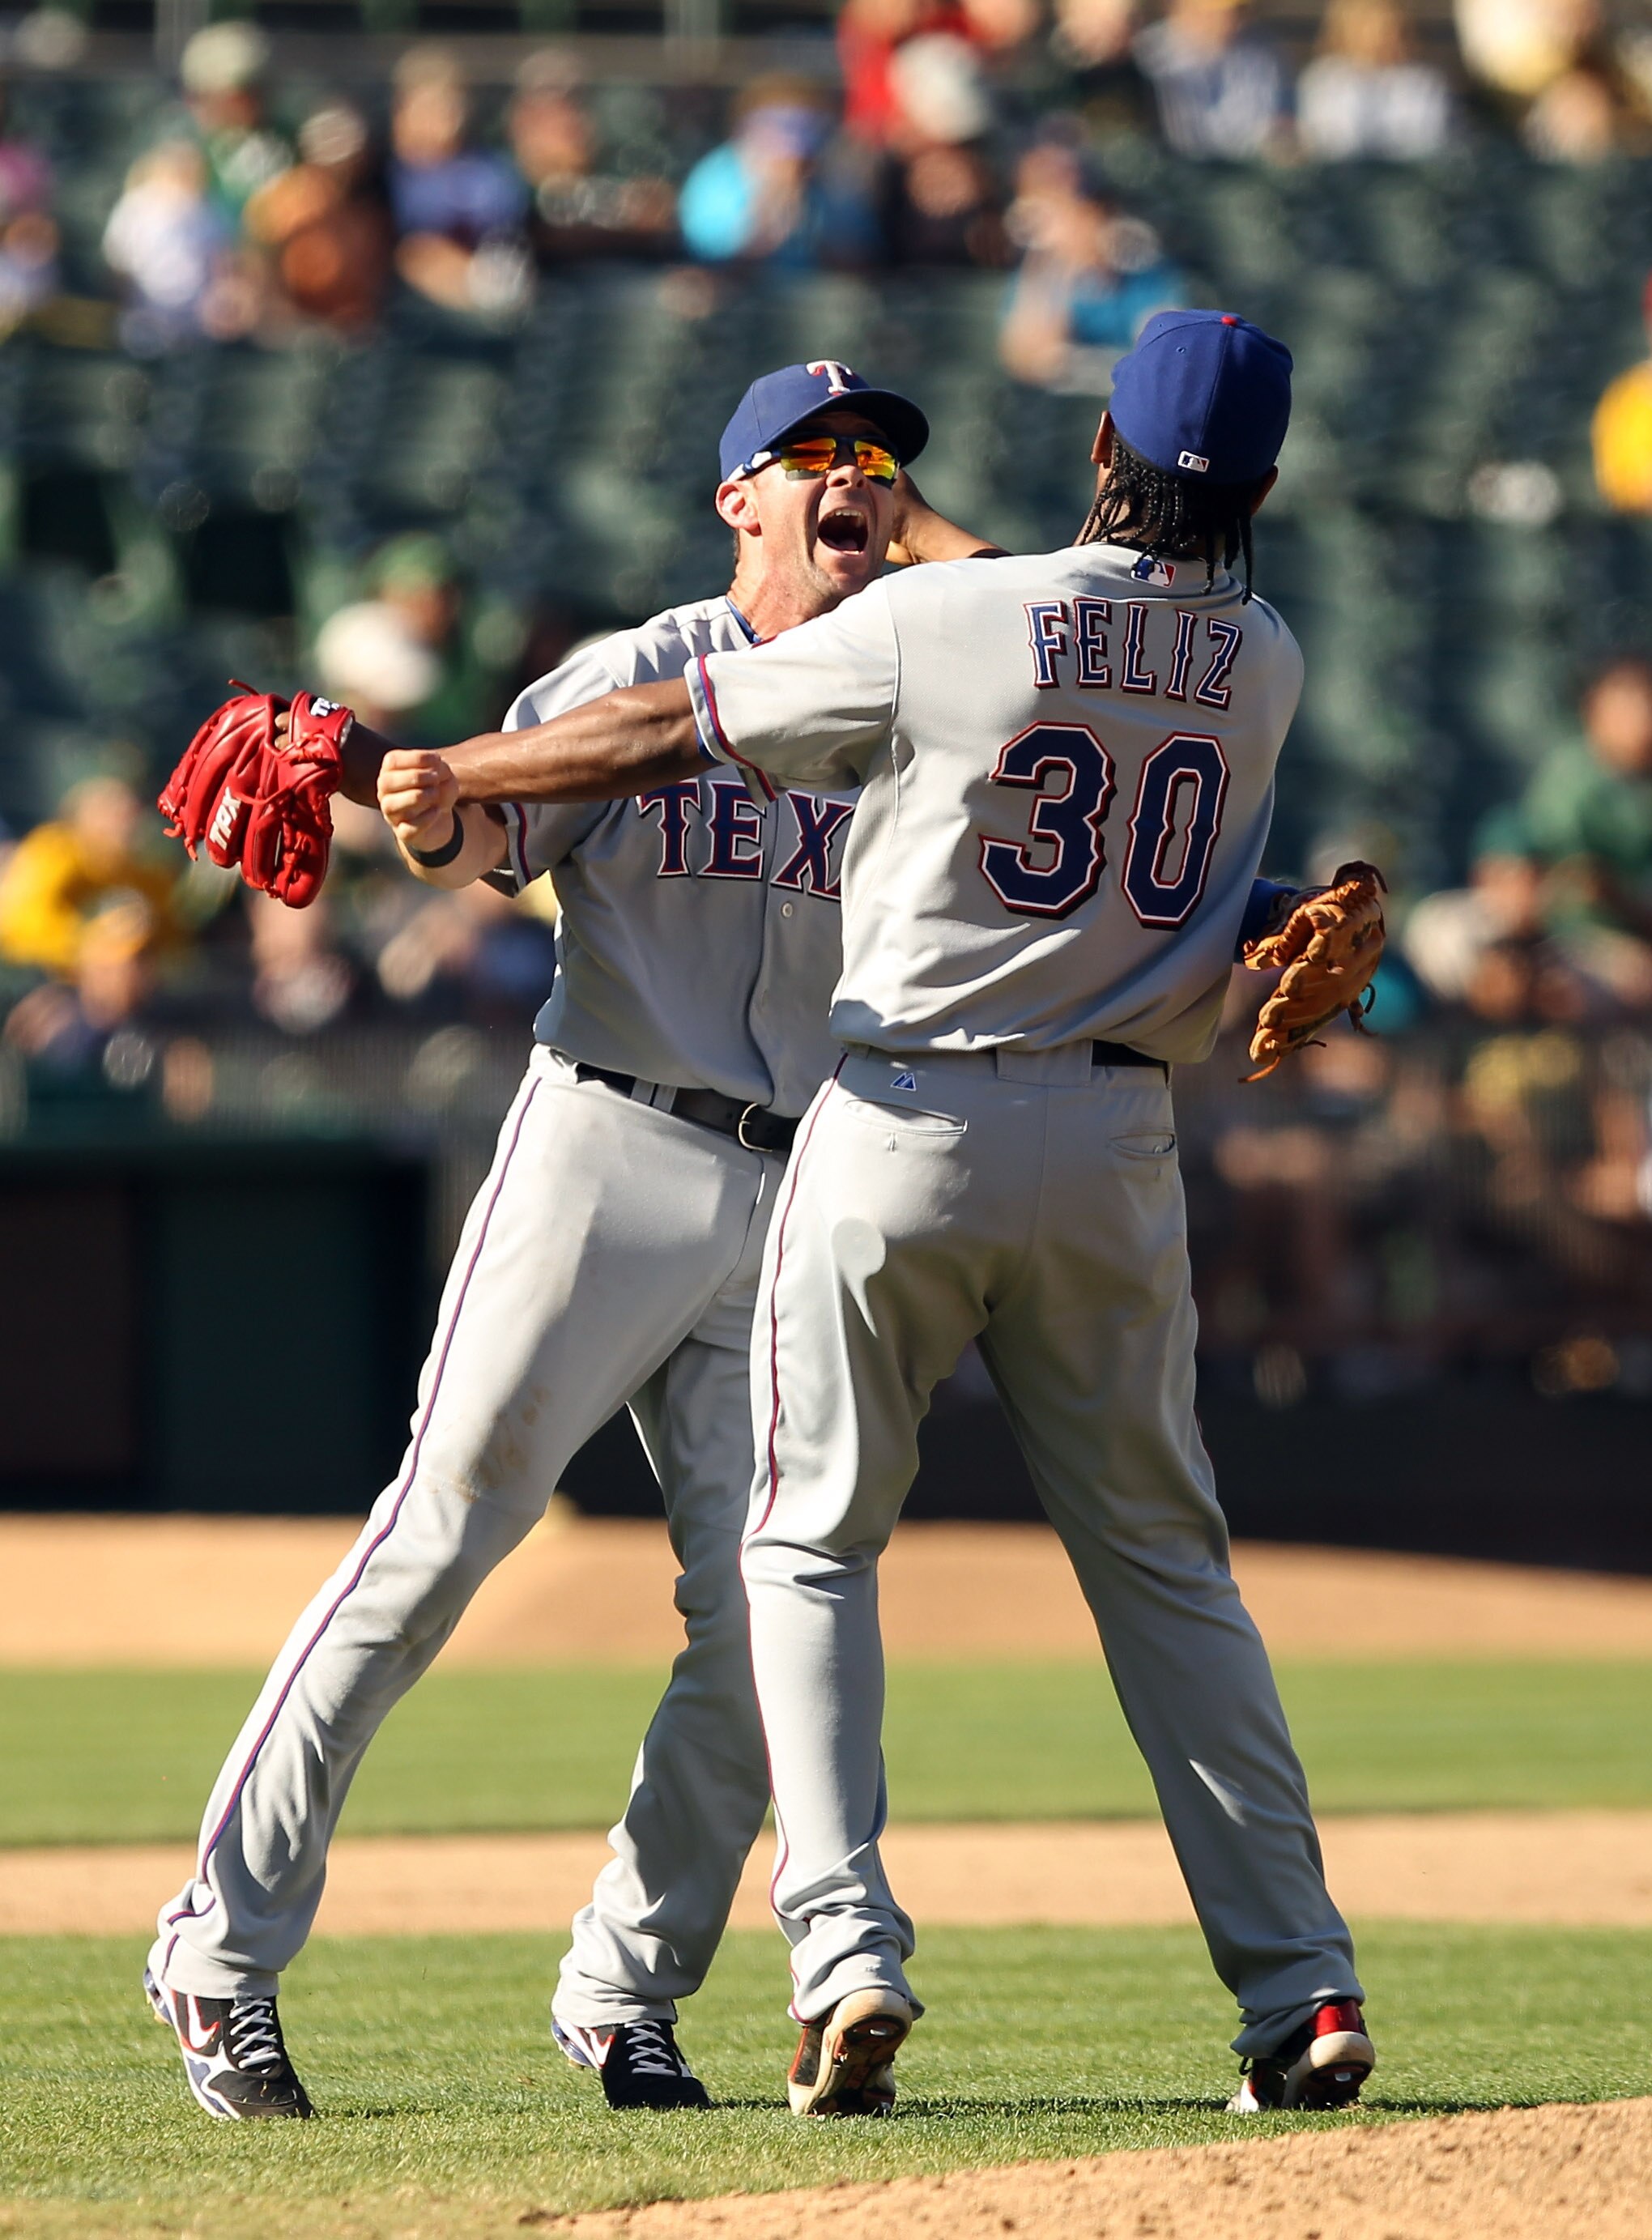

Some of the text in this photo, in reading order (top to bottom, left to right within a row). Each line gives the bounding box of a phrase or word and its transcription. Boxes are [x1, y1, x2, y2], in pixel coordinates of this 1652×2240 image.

[807, 360, 853, 396] T
[1023, 598, 1243, 709] FELIZ
[209, 786, 241, 851] TPX
[635, 778, 855, 902] TEX
[977, 720, 1231, 931] 30
